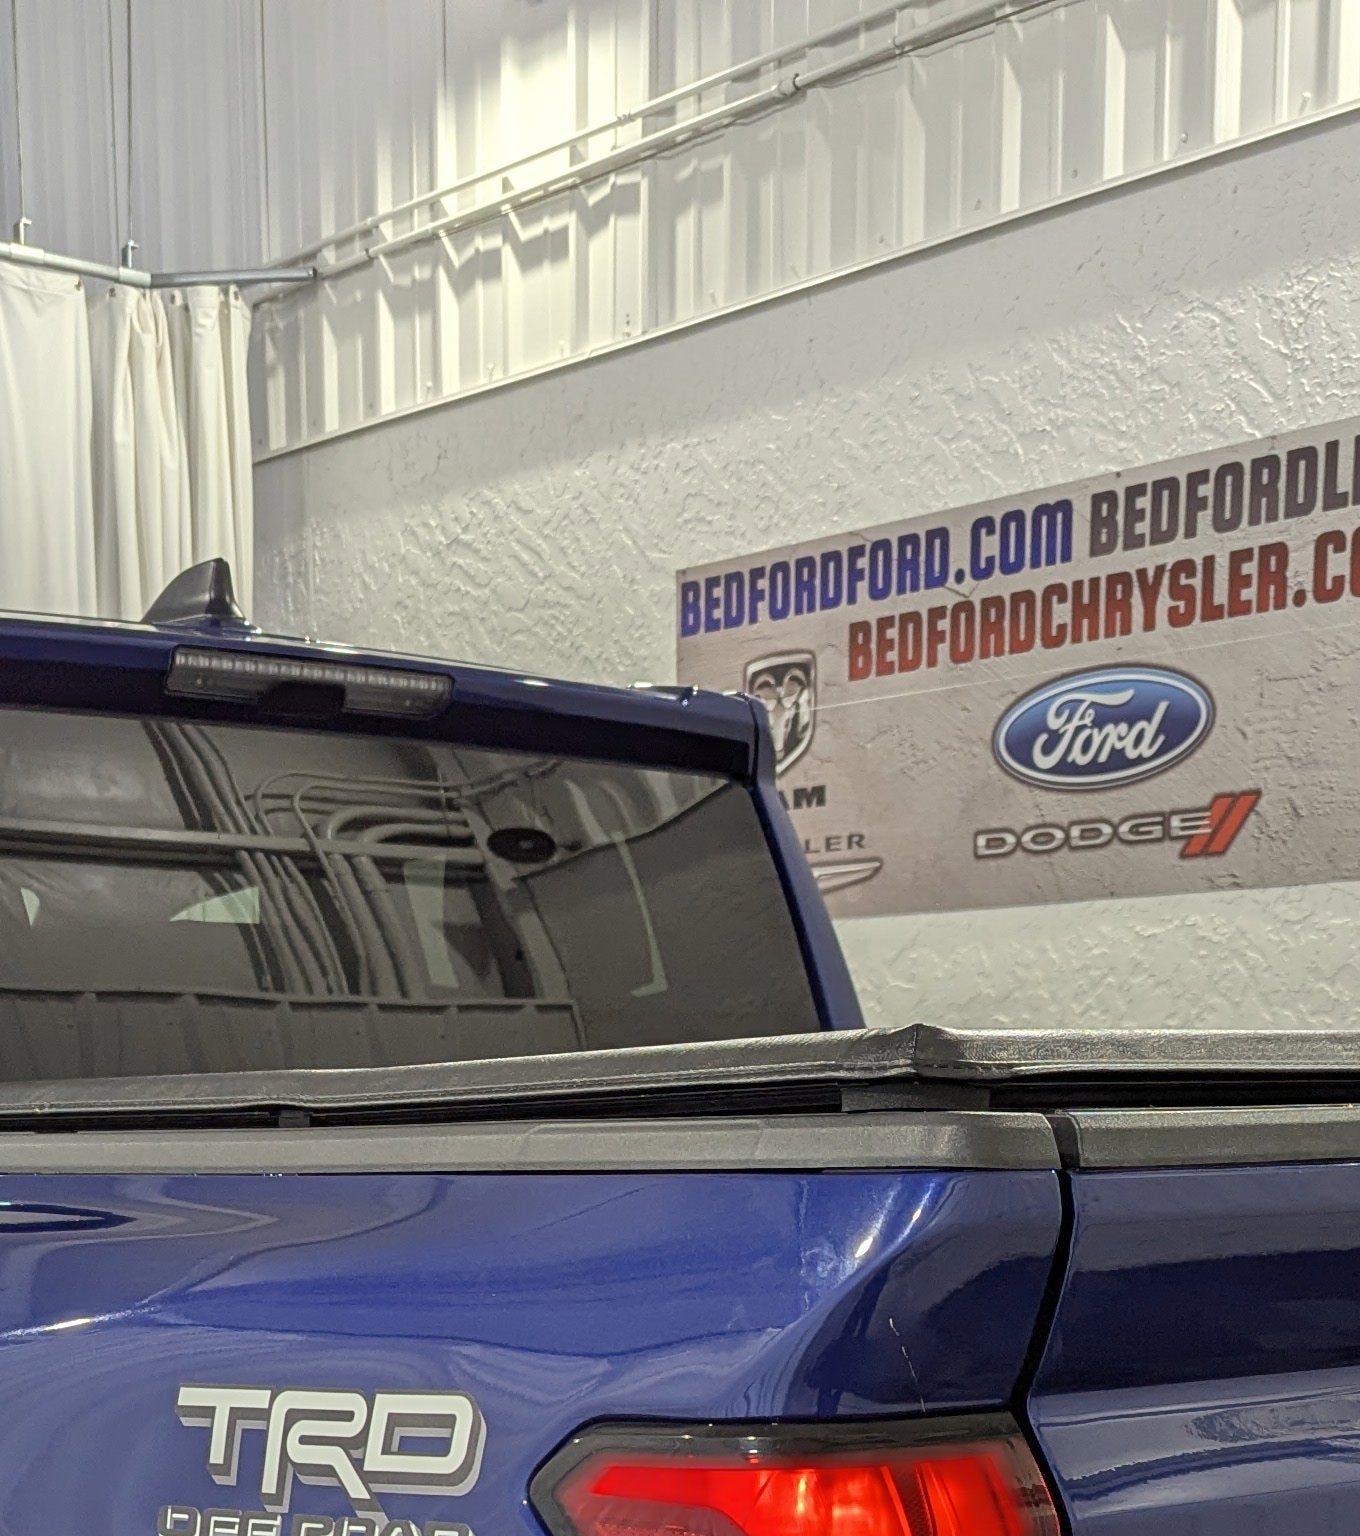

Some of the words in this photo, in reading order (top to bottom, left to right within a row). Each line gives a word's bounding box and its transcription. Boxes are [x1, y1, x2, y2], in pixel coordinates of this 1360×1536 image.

[679, 499, 1073, 637] BEDFORDFORD.COM
[1033, 688, 1170, 770] Ford
[974, 807, 1213, 860] DODGE
[175, 1383, 487, 1524] TRD
